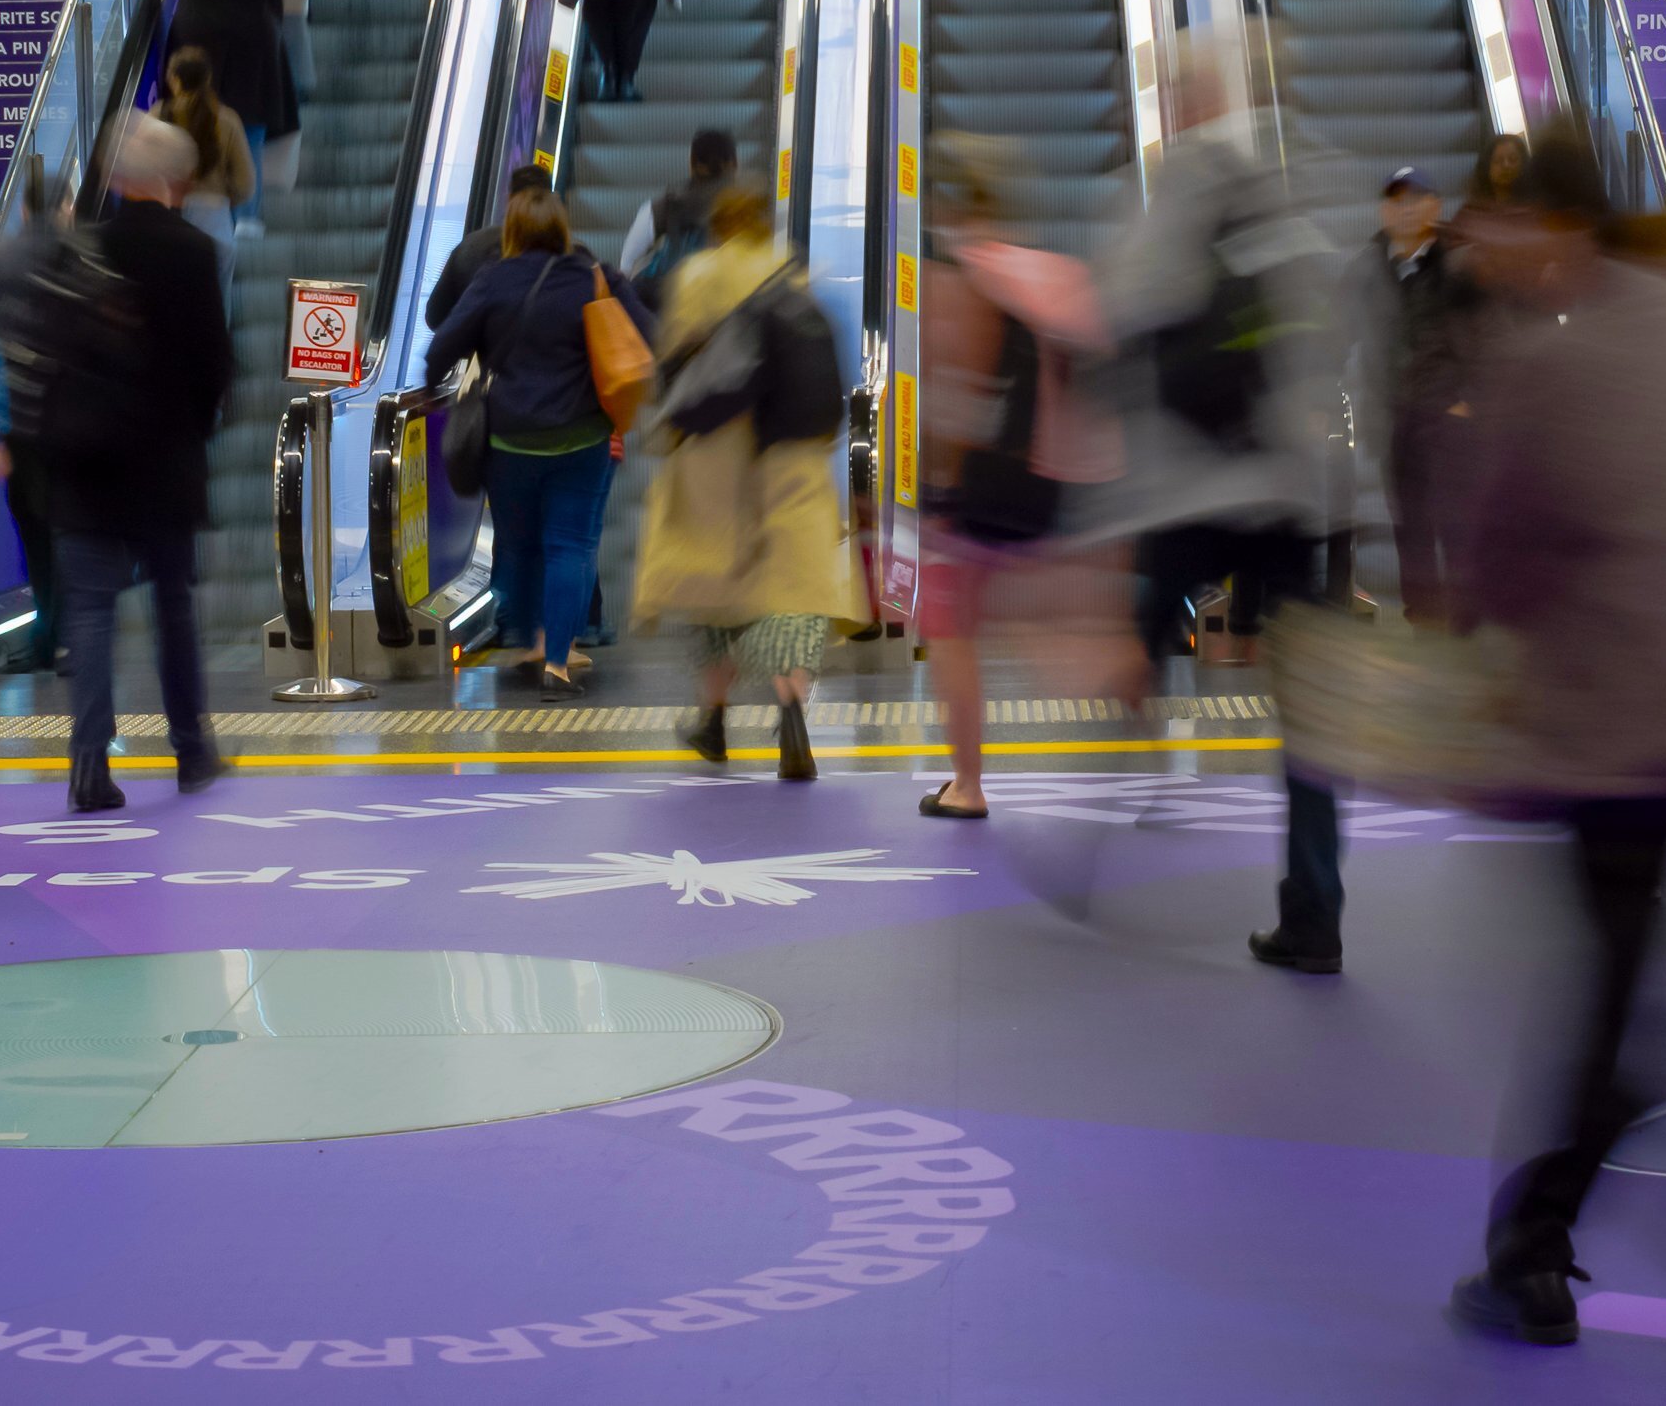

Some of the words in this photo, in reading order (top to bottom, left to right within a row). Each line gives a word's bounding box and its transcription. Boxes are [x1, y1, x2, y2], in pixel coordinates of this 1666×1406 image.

[12, 41, 42, 55] PIN
[302, 292, 353, 305] WARNING!
[297, 349, 311, 357] NO
[311, 350, 332, 360] BAGS
[333, 352, 347, 361] ON
[299, 360, 343, 371] ESCALATOR
